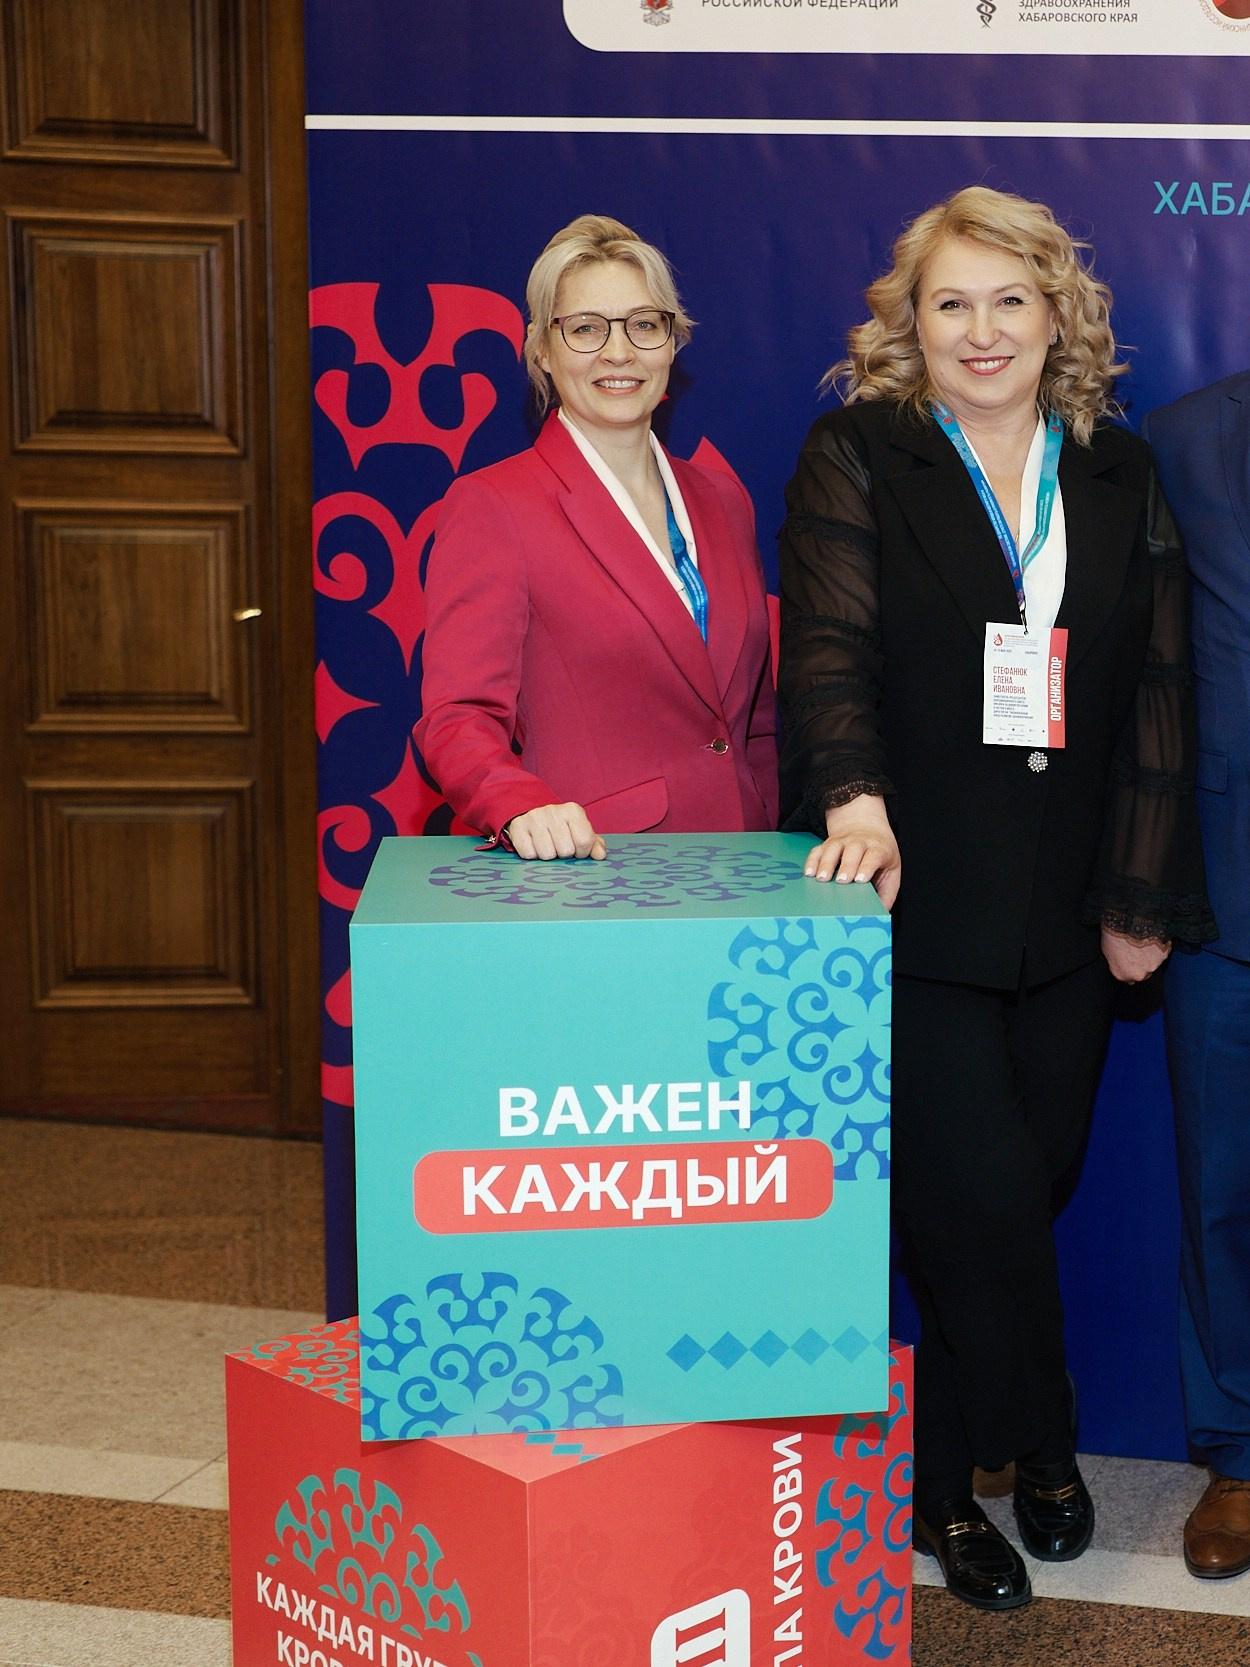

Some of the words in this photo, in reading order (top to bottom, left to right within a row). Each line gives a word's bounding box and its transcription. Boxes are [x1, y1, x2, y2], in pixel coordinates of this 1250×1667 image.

[1018, 12, 1107, 22] ХАБАРОВСКОГО
[1110, 13, 1138, 22] КРАЯ
[993, 666, 1028, 677] СТЕФАНЮК
[993, 675, 1013, 685] ЕЛЕНА
[993, 685, 1026, 695] ИВАНОВНА
[1050, 656, 1062, 721] ОРГАНИЗАТОР
[499, 1080, 752, 1137] ВАЖЕН
[462, 1143, 788, 1220] КАЖДЫЙ
[773, 1433, 803, 1605] КРОВИ
[256, 1571, 374, 1661] КАЖДАЯ
[380, 1634, 449, 1667] ГРУ
